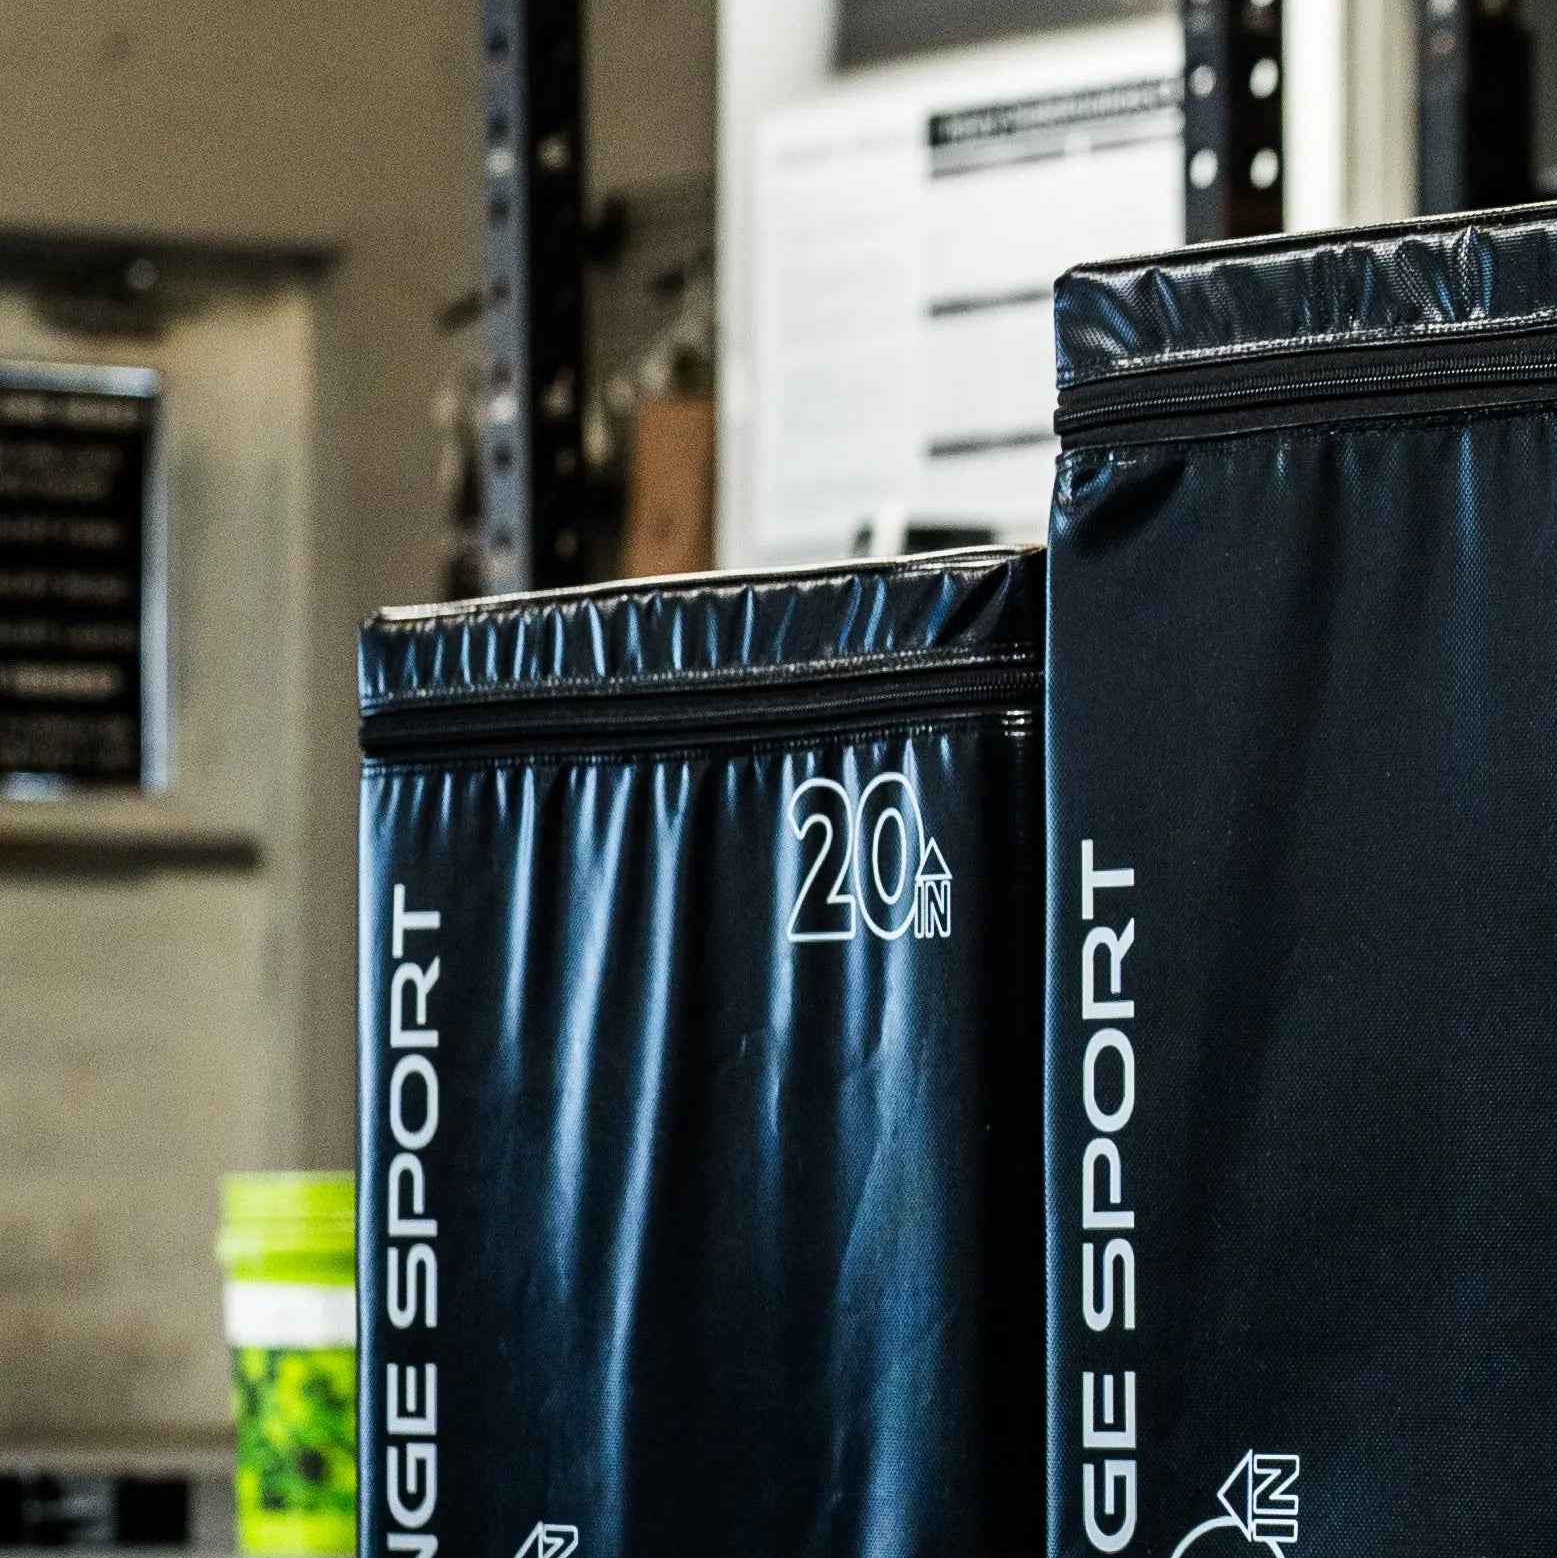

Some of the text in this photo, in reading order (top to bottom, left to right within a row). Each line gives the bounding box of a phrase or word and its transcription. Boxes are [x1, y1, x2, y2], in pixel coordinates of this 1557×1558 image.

[786, 771, 951, 942] 20 IN
[386, 882, 442, 1329] SPORT
[1080, 837, 1137, 1333] SPORT
[1252, 1453, 1300, 1543] IN
